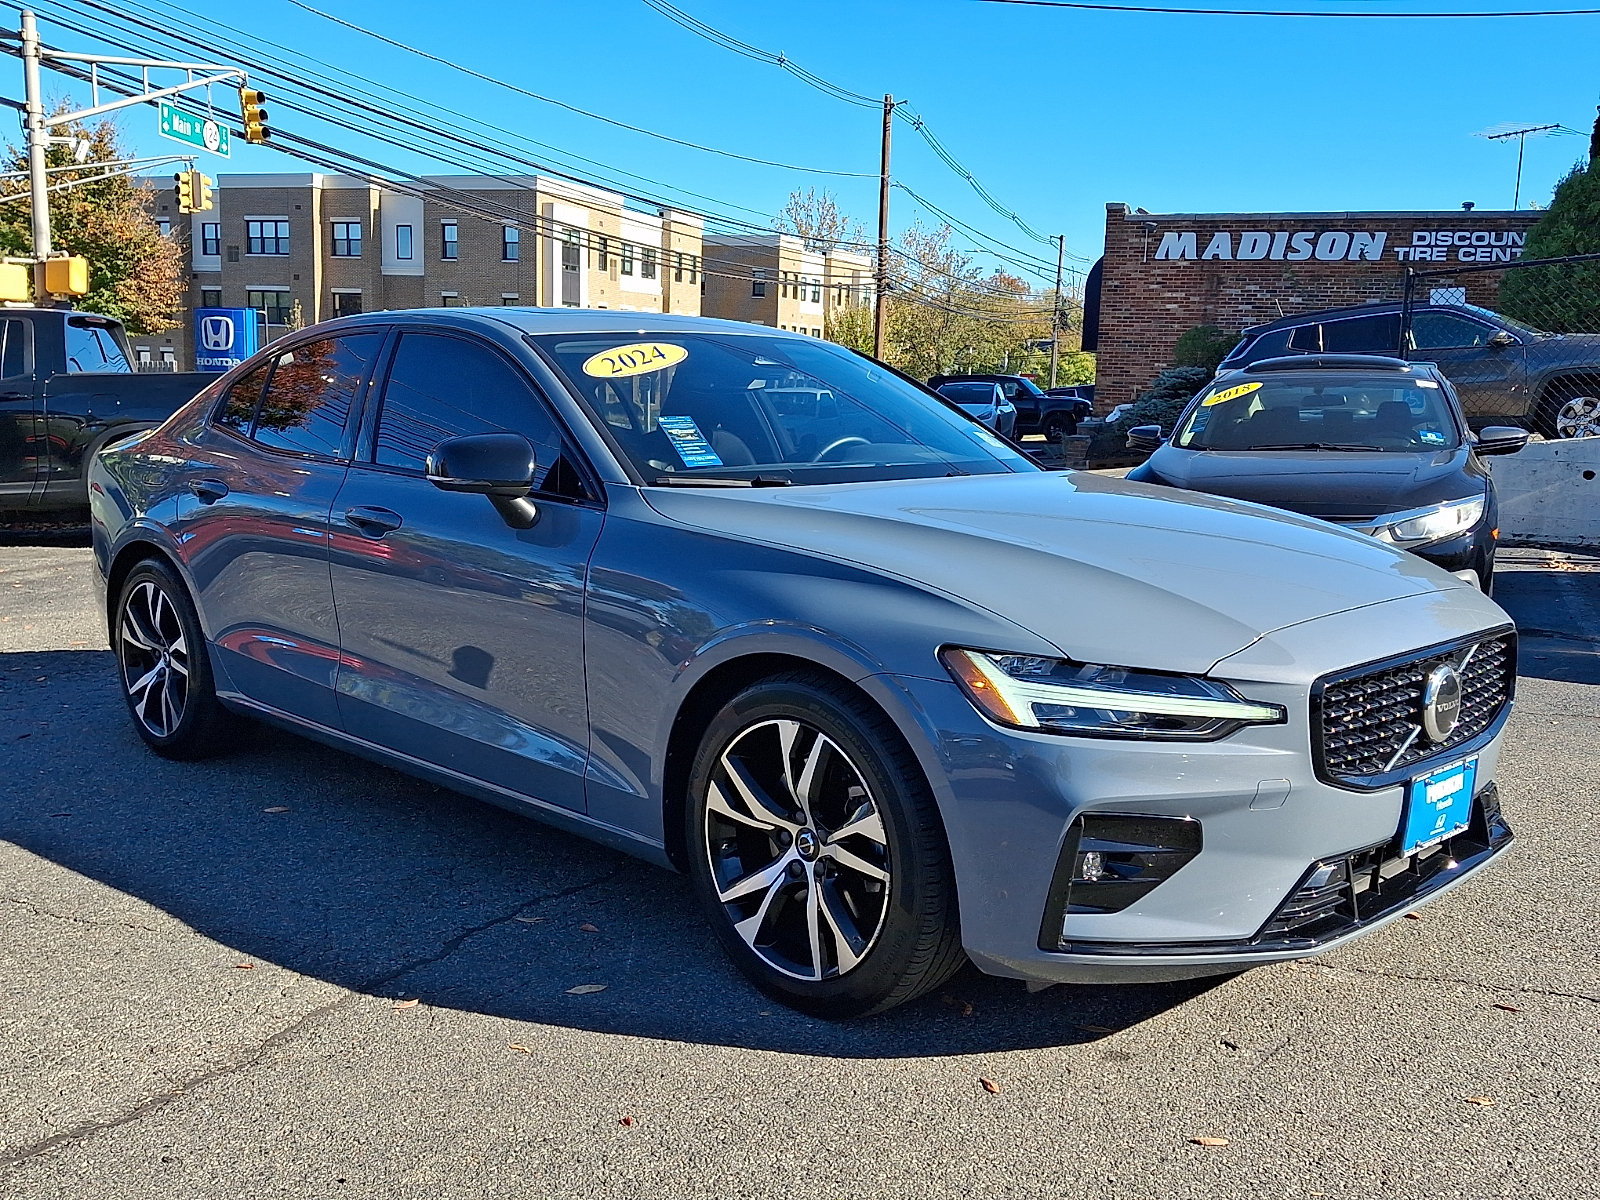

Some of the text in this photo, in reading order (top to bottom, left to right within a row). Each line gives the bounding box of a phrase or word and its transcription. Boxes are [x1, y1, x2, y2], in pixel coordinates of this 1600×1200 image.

[173, 113, 192, 136] Main
[204, 126, 218, 143] 124
[1154, 231, 1388, 260] MADISON
[1393, 247, 1448, 261] TIRE
[195, 357, 241, 367] HONDA
[601, 345, 667, 374] 2024
[1214, 384, 1251, 403] 2018
